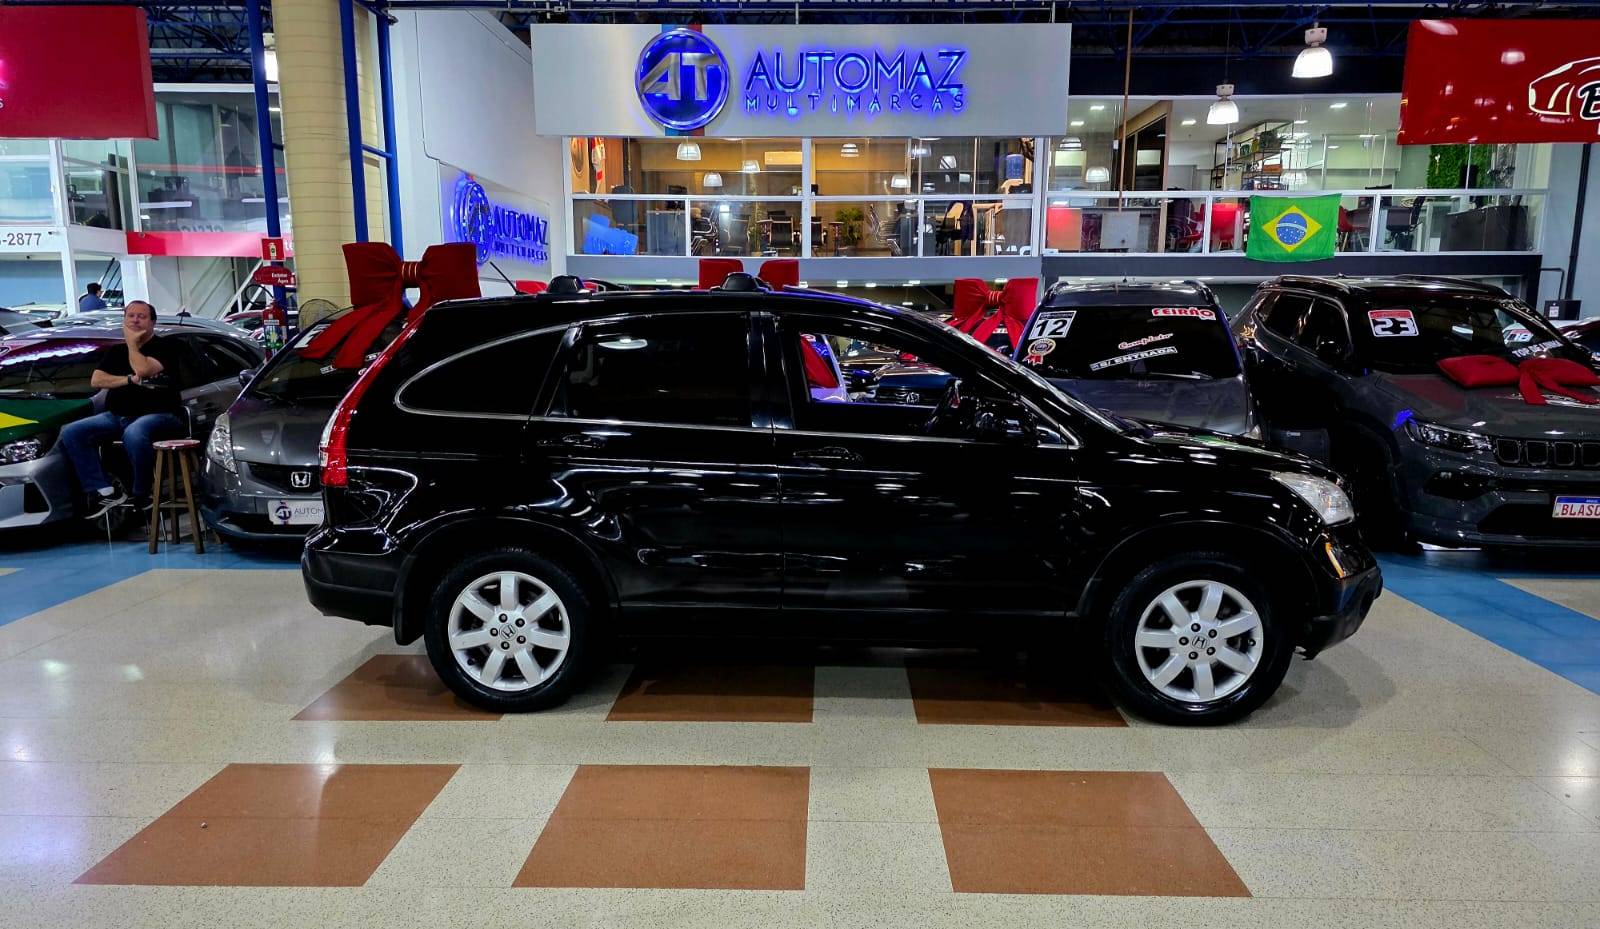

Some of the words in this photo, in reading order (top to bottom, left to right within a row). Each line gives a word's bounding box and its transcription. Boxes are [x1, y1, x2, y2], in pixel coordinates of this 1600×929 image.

[746, 49, 967, 92] AUTOMAZ
[746, 94, 964, 113] MULTIMARCAS
[492, 205, 548, 246] AUTOMAZ
[0, 232, 42, 246] -2877
[1152, 307, 1215, 318] FEIRÃO
[1036, 319, 1068, 338] 12
[1375, 318, 1416, 335] 23
[1113, 346, 1175, 365] ENTRADA
